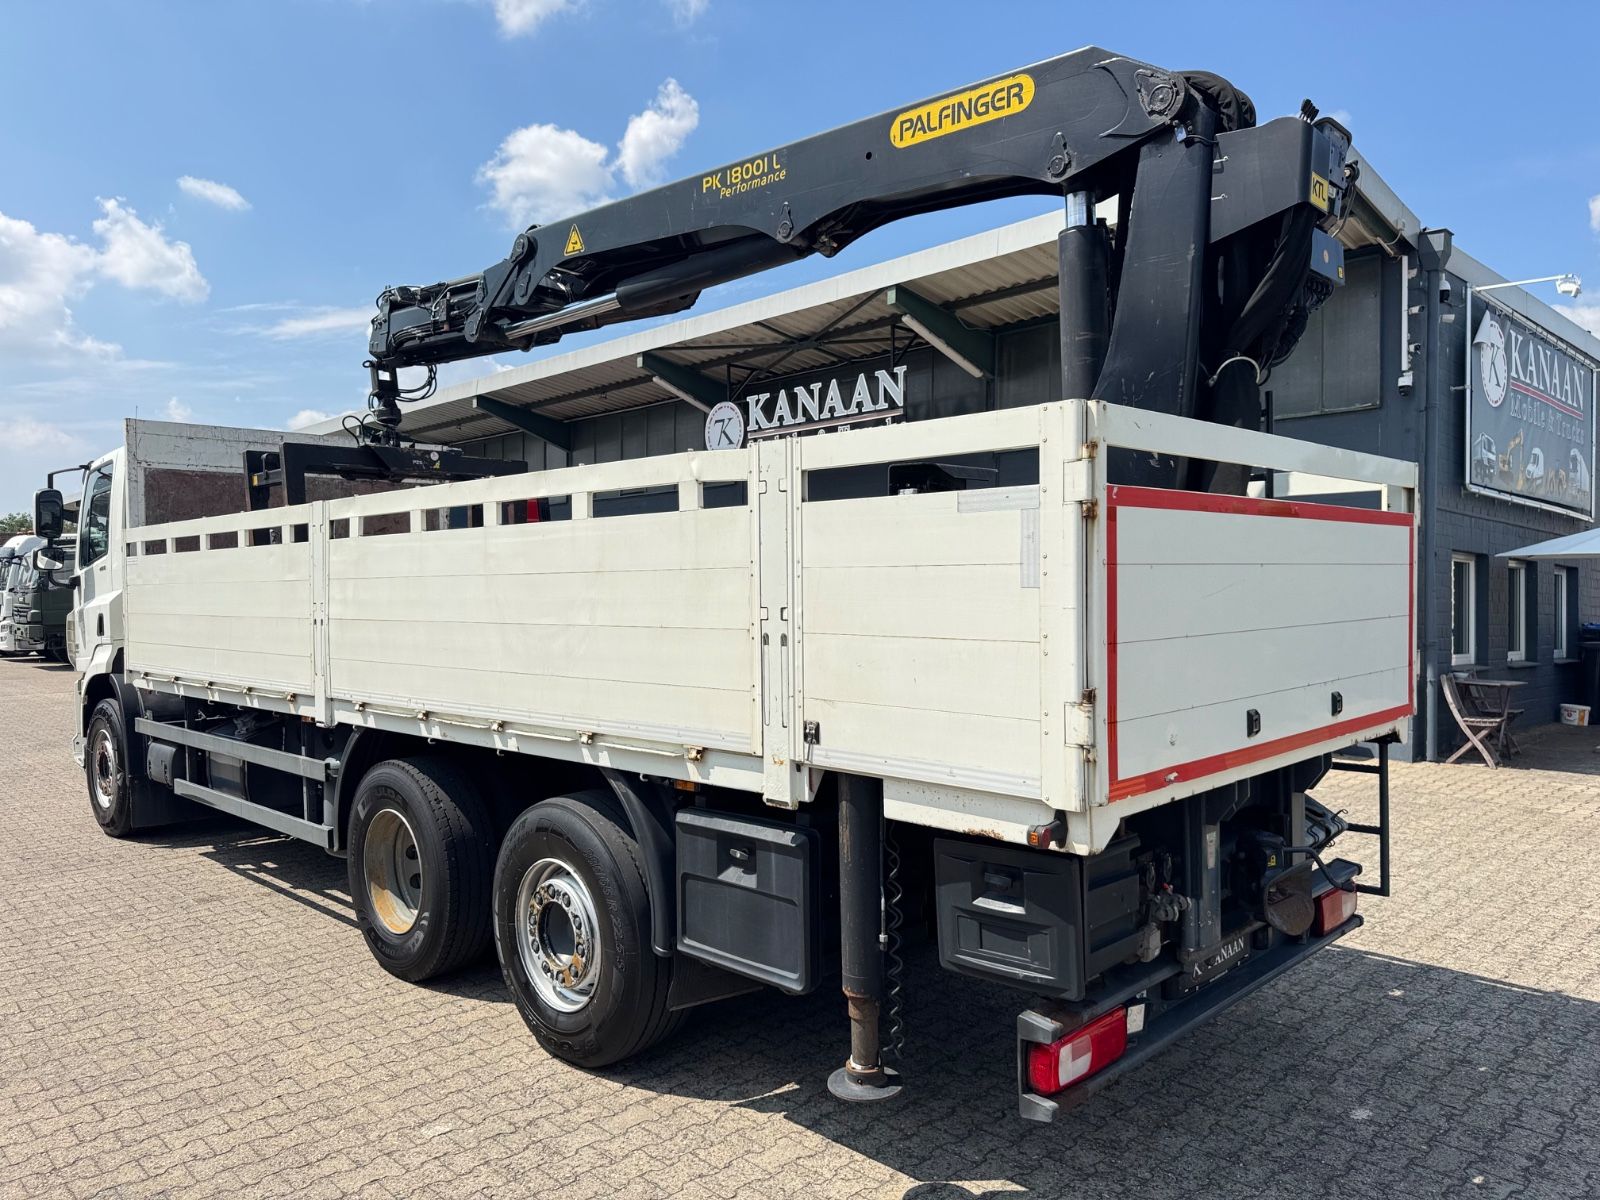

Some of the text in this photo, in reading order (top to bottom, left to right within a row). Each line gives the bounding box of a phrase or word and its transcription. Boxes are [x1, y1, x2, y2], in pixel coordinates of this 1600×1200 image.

[899, 82, 1025, 142] PALFINGER
[702, 153, 781, 194] PK 18001 L
[720, 169, 787, 200] Performance
[1311, 176, 1327, 202] KTL
[1509, 329, 1585, 411] KANAAN
[746, 365, 908, 432] KANAAN
[1510, 392, 1546, 430] Mobile
[1556, 412, 1585, 446] Trucks
